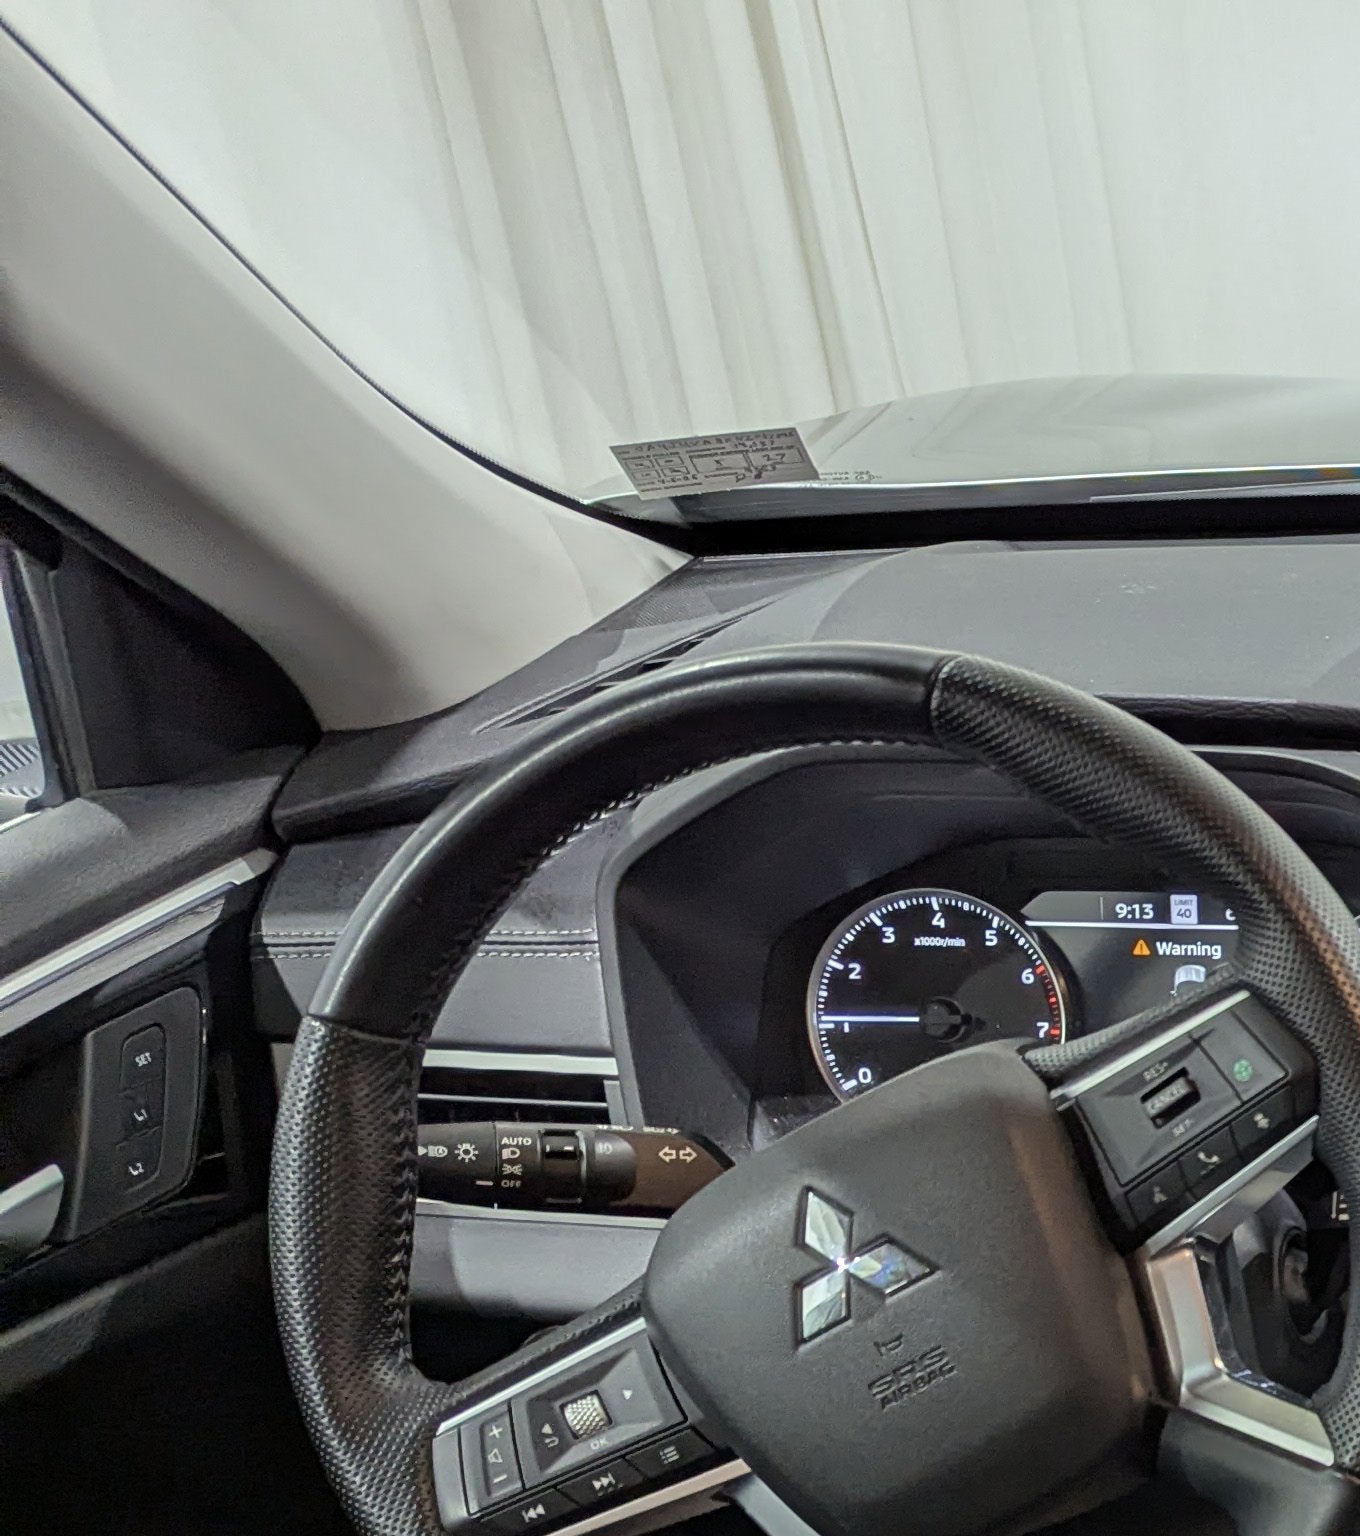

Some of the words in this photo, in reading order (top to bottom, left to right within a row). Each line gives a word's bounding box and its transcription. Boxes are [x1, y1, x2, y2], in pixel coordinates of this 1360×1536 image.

[1115, 903, 1154, 919] 9:13
[1176, 908, 1192, 919] 40
[931, 912, 946, 929] 4
[881, 927, 895, 943] 3
[984, 930, 998, 946] 5
[1156, 941, 1222, 959] Warning
[848, 963, 862, 980] 2
[1021, 968, 1035, 985] 6
[1036, 1022, 1050, 1038] 7
[135, 1052, 152, 1067] SET
[858, 1068, 872, 1084] 0
[502, 1136, 532, 1147] AUTO
[501, 1179, 522, 1189] OFF
[590, 1436, 609, 1450] OK
